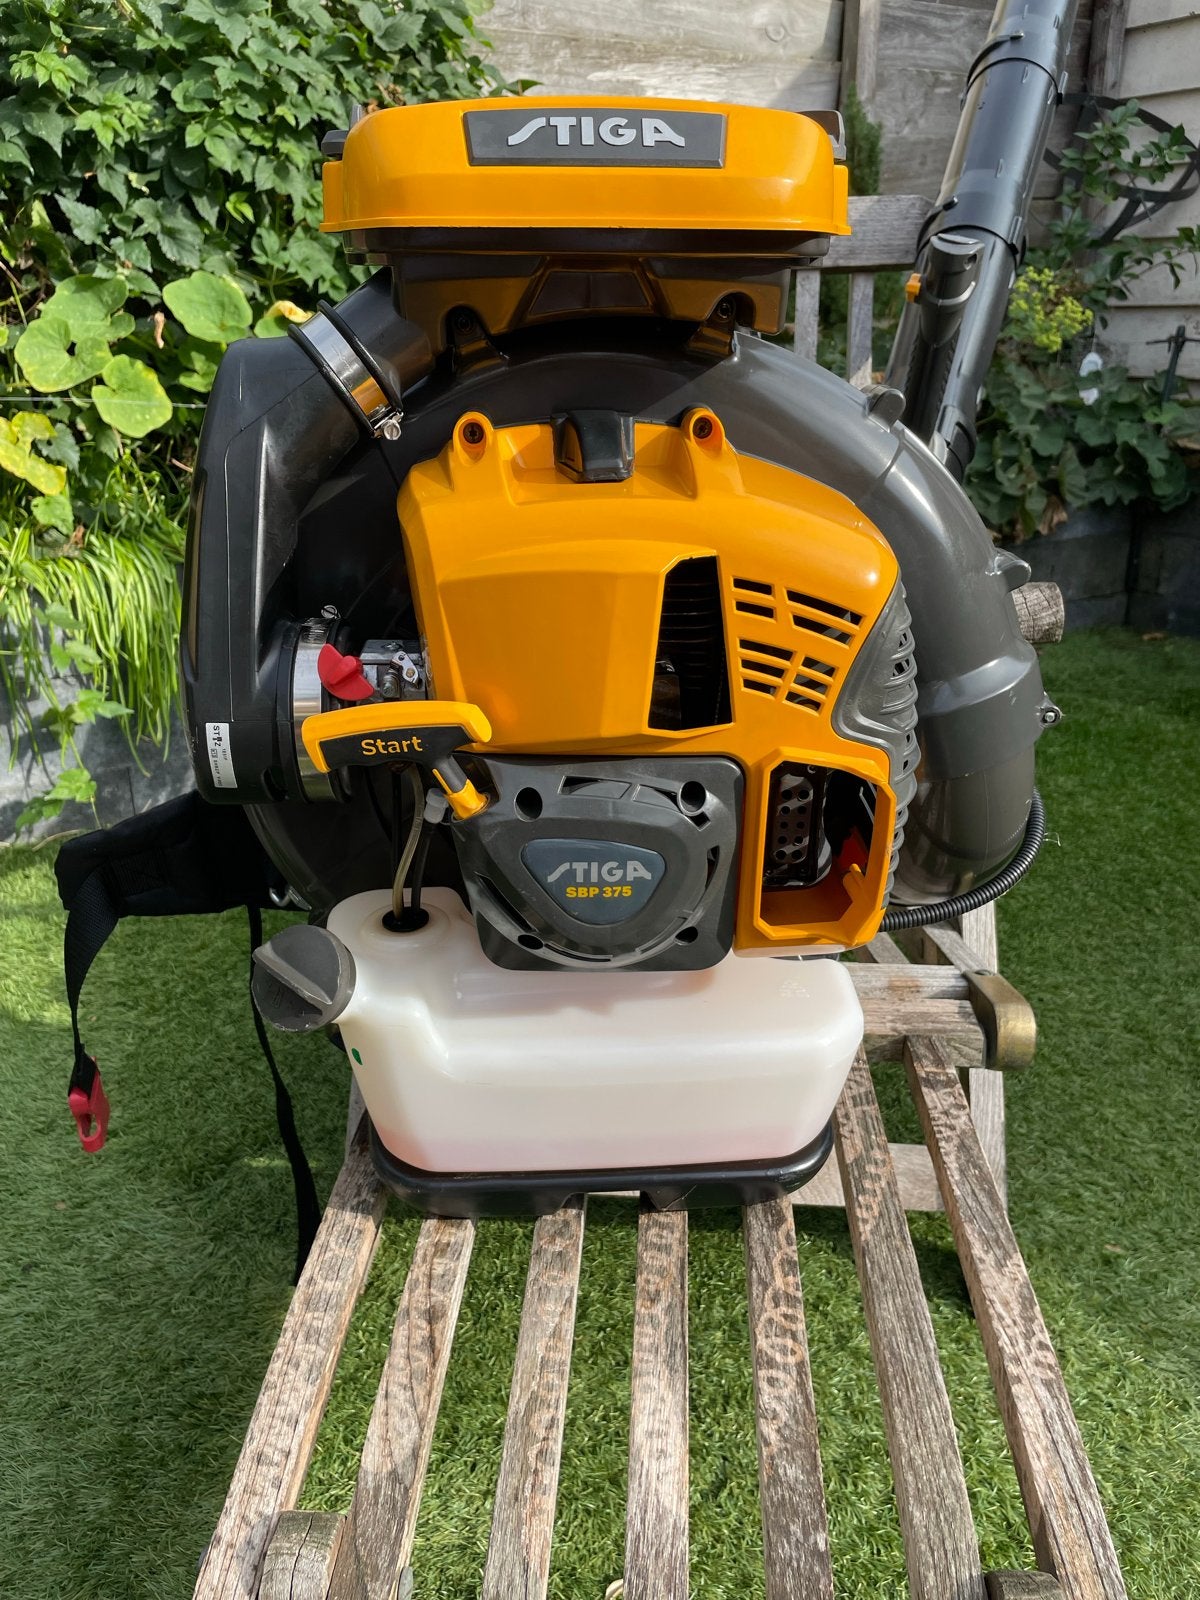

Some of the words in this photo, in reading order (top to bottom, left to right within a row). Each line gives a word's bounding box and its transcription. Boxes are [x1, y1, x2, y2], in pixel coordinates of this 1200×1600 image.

[507, 116, 685, 147] STIGA
[361, 736, 423, 756] Start
[547, 860, 652, 883] STIGA
[565, 886, 600, 898] SBP
[602, 885, 633, 898] 375
